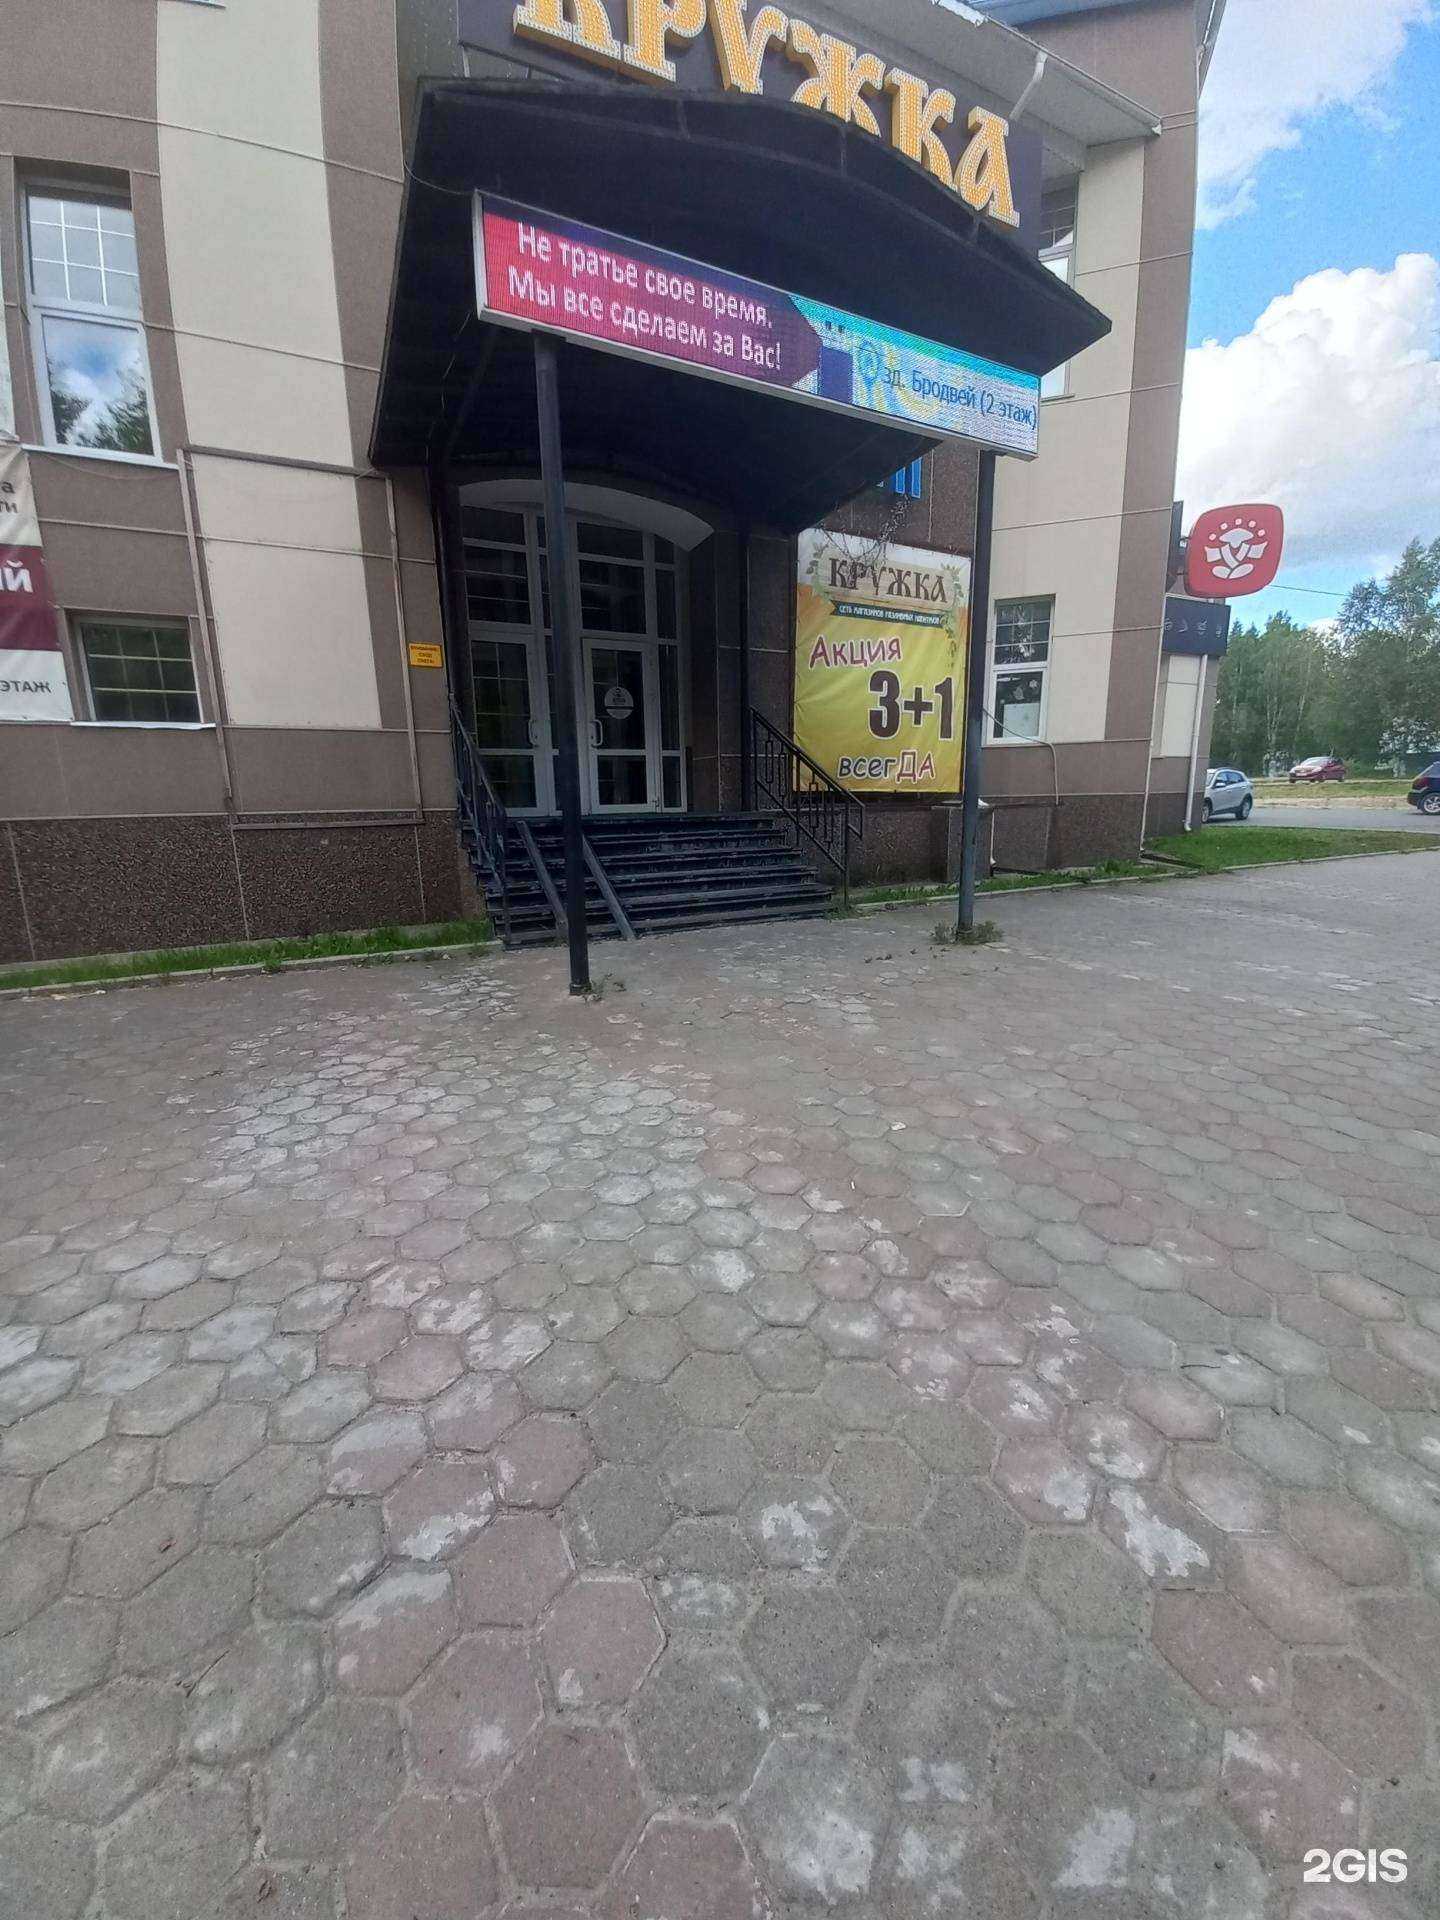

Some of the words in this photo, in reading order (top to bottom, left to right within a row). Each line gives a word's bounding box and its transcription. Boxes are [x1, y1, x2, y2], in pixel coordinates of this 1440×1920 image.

[518, 222, 551, 262] Не
[559, 240, 638, 288] тратье
[645, 267, 696, 304] свое
[508, 265, 555, 308] Мы
[563, 285, 604, 321] все
[610, 300, 707, 349] сделаем
[712, 329, 734, 358] за
[741, 333, 782, 370] Вас!
[912, 369, 977, 407] Бродвей
[979, 391, 995, 417] (2
[999, 404, 1037, 430] этаж)
[829, 558, 948, 603] КРУЖКА
[0, 680, 51, 693] ЭТАЖ
[869, 670, 954, 740] 3+1
